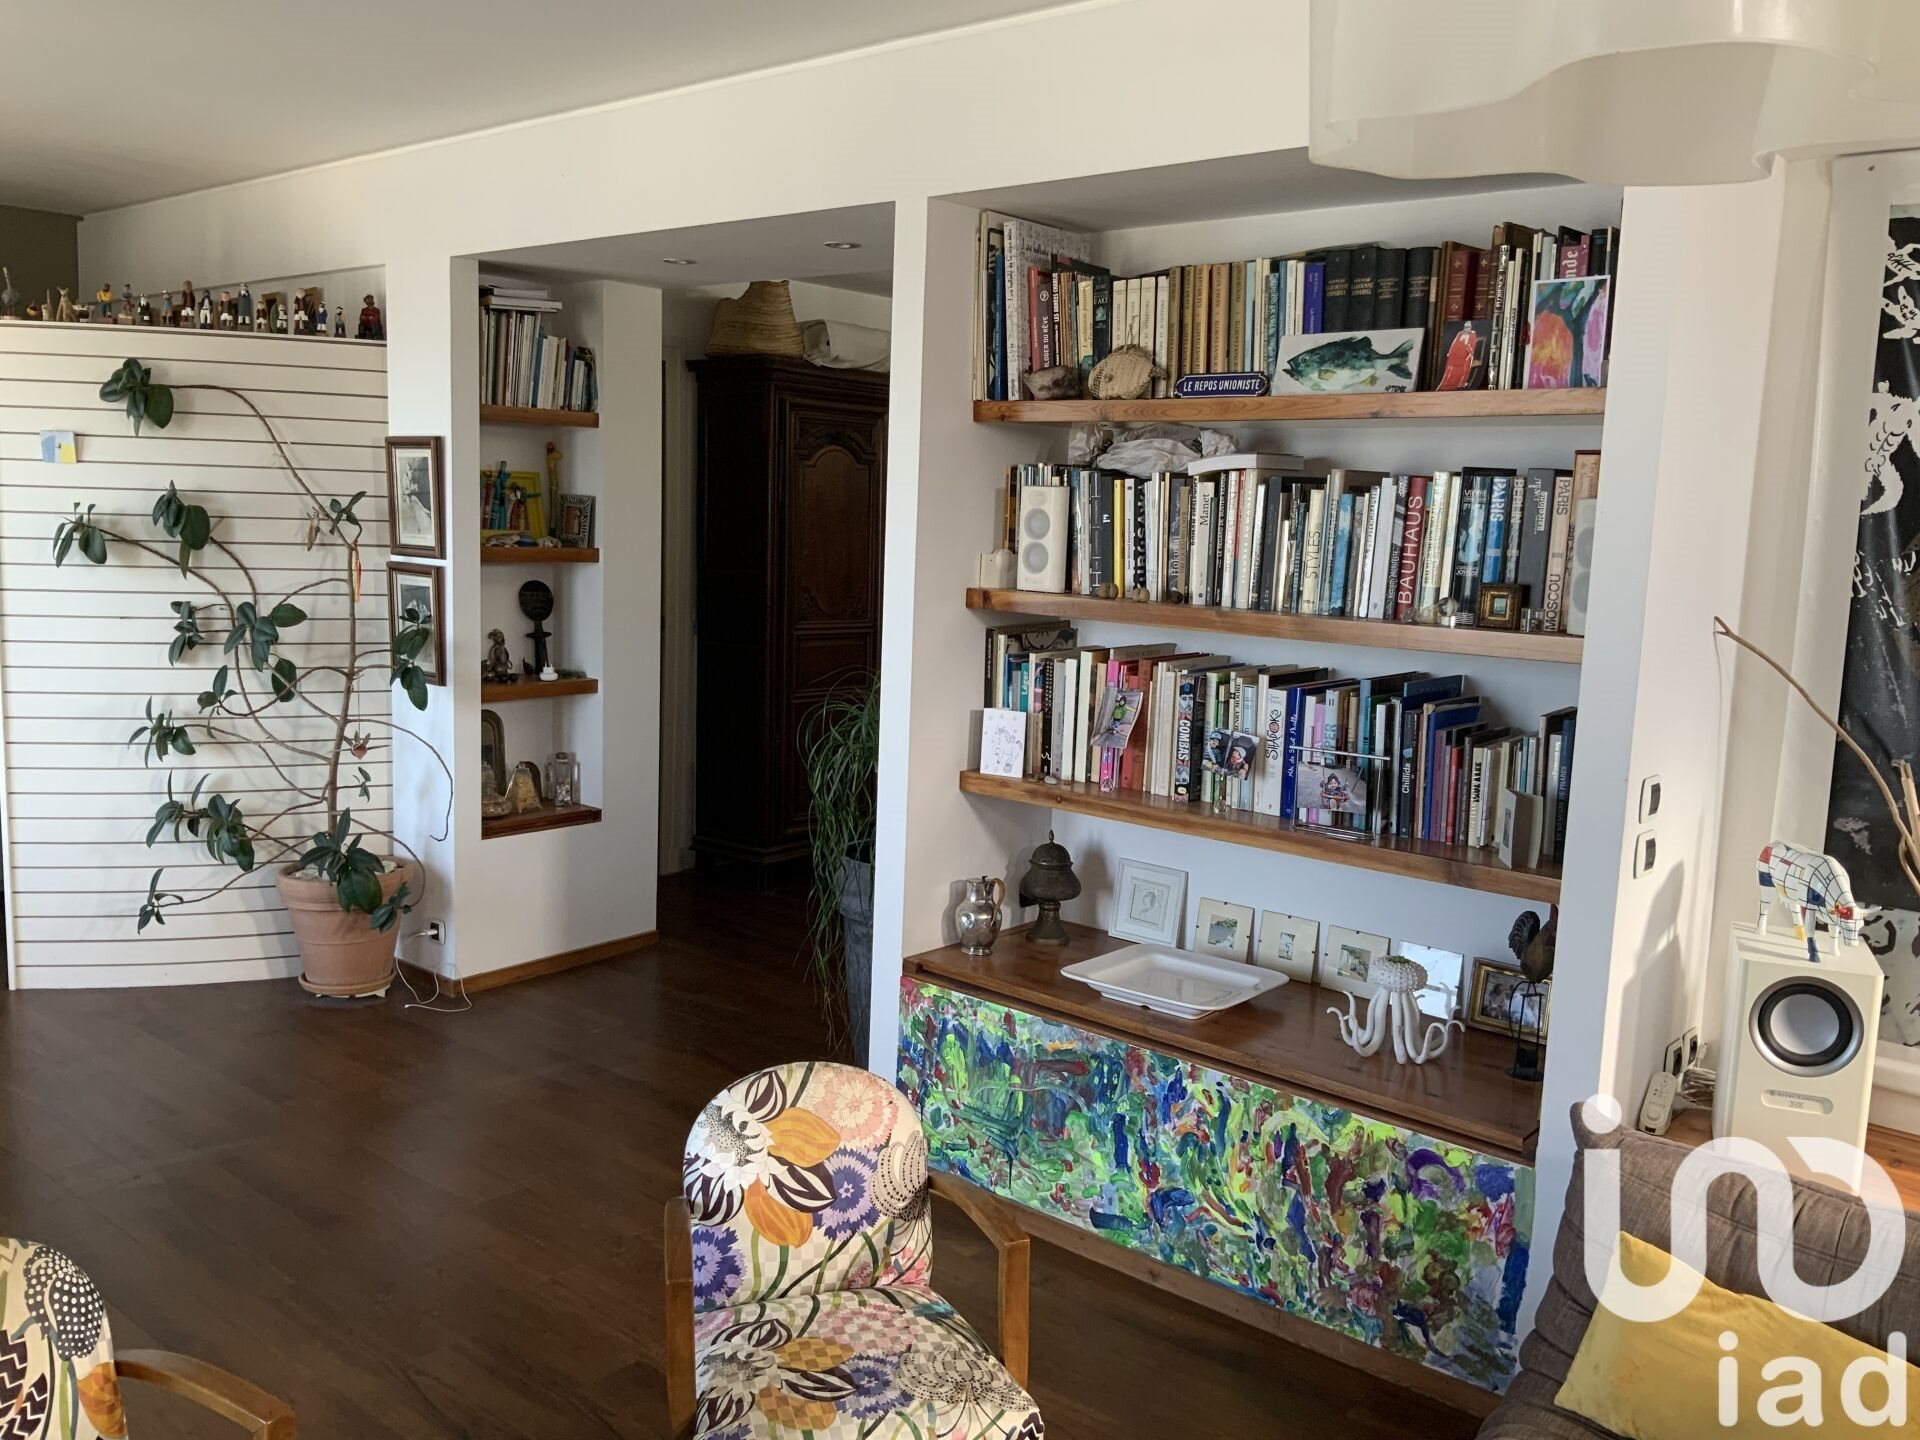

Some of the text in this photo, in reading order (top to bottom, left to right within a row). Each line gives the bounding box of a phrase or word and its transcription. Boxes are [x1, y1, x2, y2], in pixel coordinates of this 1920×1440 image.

[1563, 250, 1578, 279] nde
[1041, 315, 1049, 333] RÊVE
[1183, 379, 1260, 392] LE REPOS UNIONISTE
[1200, 493, 1210, 526] Manet
[1490, 478, 1507, 522] PARIS
[1511, 477, 1525, 524] BERLIN
[1556, 479, 1570, 516] PARIS
[1305, 530, 1321, 579] STYLES
[1398, 495, 1424, 605] BAUHAUS
[1545, 573, 1561, 631] MOSCOU
[1021, 671, 1029, 695] Léger
[1233, 682, 1241, 709] MOORE
[1177, 719, 1191, 761] COMBAS
[1265, 709, 1282, 761] SHADOKS
[1402, 762, 1411, 794] Chillida
[1559, 766, 1567, 791] PHARES
